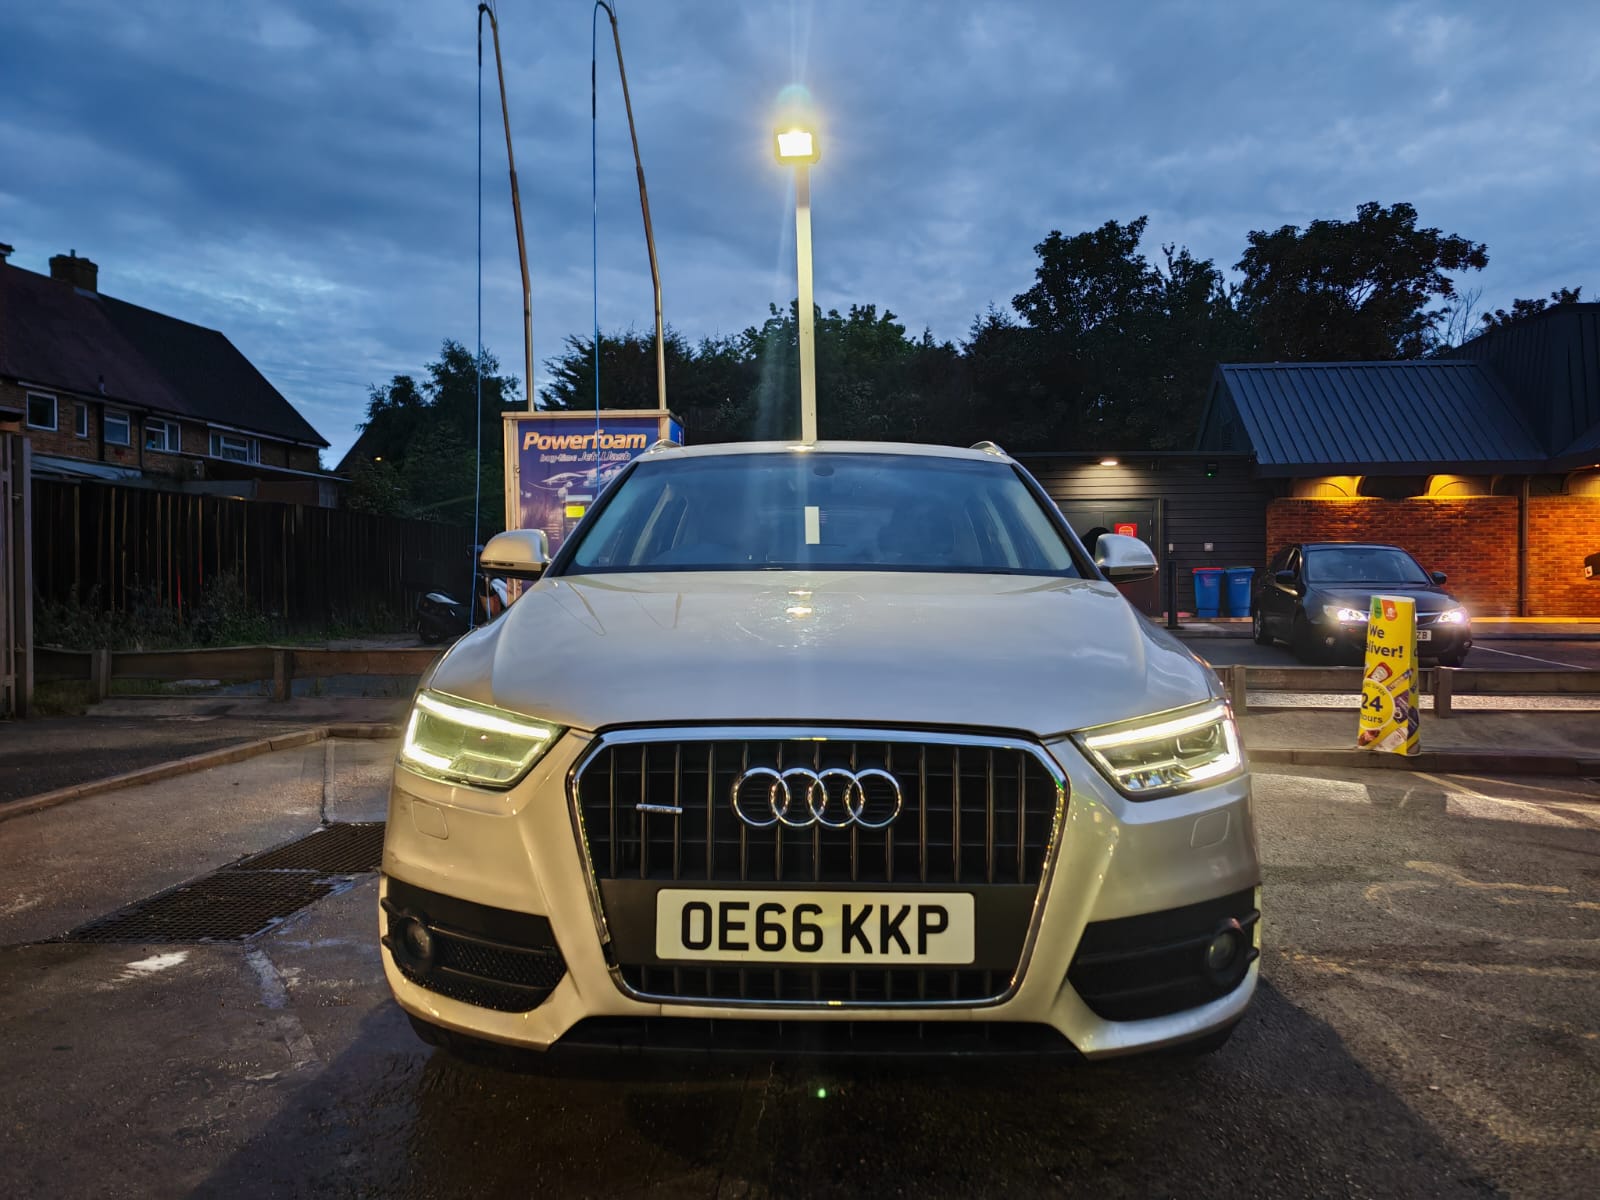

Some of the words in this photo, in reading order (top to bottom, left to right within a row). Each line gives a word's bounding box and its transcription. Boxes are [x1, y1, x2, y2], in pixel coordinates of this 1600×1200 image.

[523, 429, 647, 450] Powerfoam
[1369, 624, 1385, 639] We
[1361, 692, 1383, 712] 24
[681, 901, 823, 952] OE66
[841, 904, 949, 955] KKP
